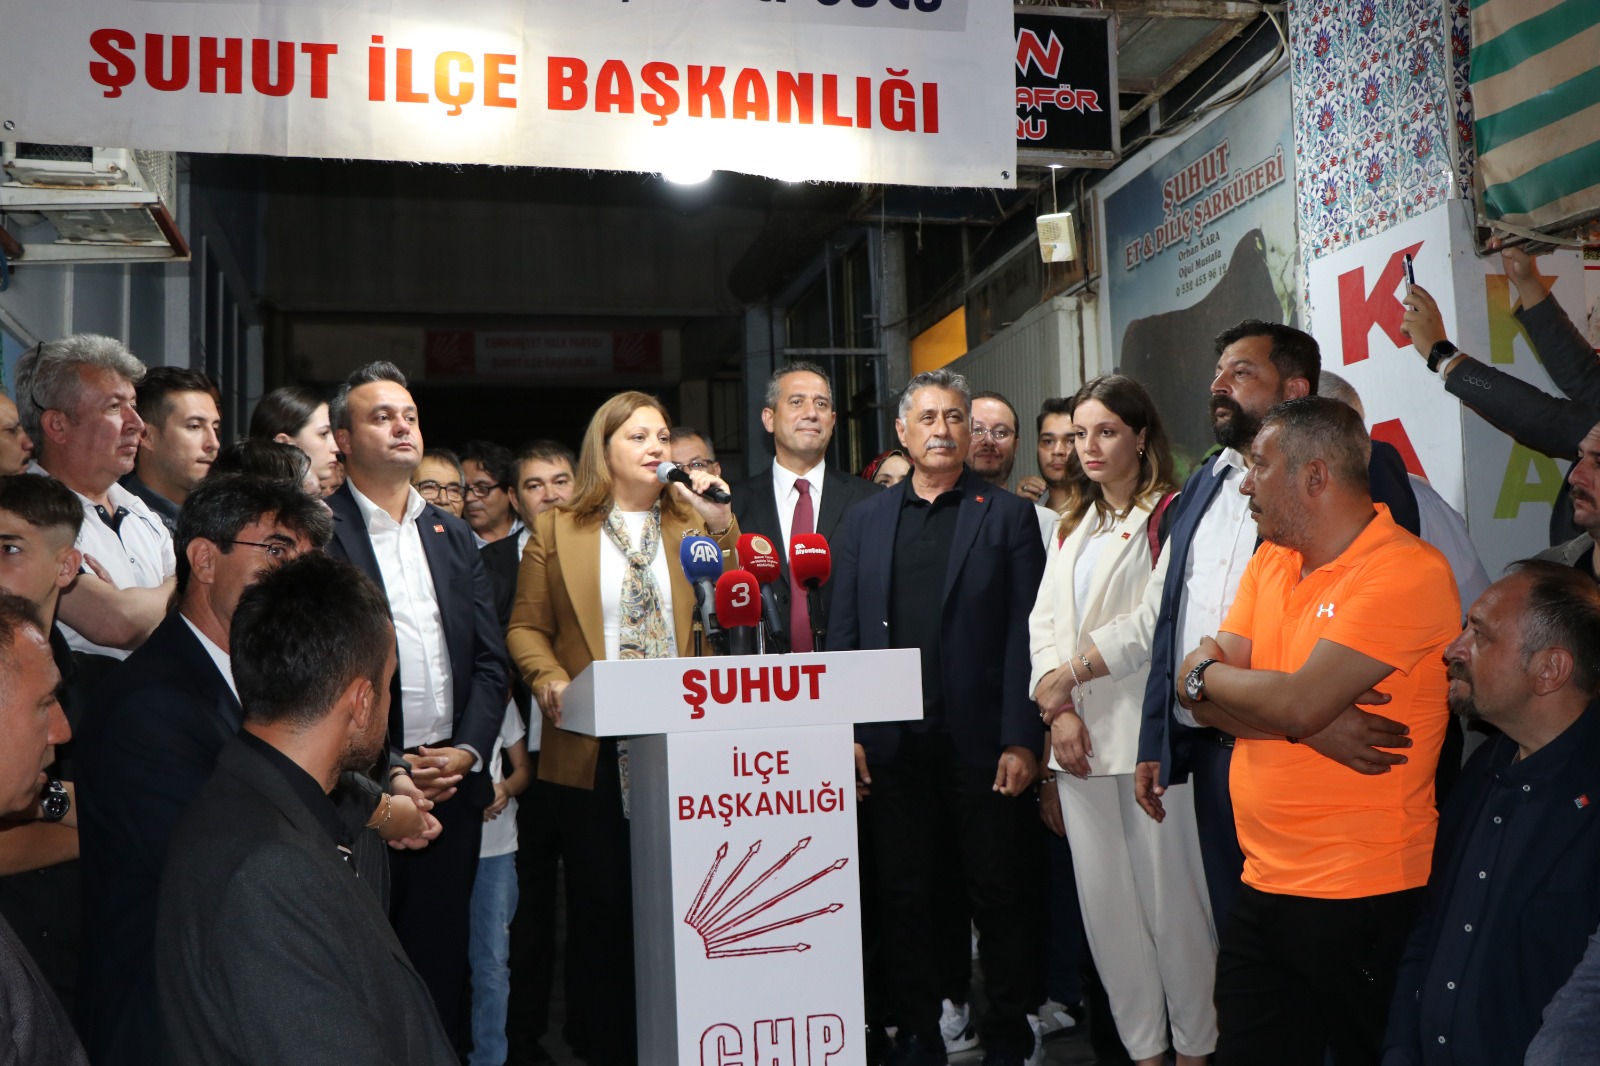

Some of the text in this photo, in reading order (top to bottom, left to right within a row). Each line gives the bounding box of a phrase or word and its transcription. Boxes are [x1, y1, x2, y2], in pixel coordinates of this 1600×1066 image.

[89, 28, 939, 134] ŞUHUT İLÇE BAŞKANLIĞI
[1163, 141, 1229, 217] ŞUHUT
[1125, 240, 1142, 269] ET
[1155, 211, 1192, 249] PİLİÇ
[1194, 147, 1285, 235] ŞARKÜTERİ
[1178, 231, 1221, 262] Orhan KARA
[1195, 249, 1222, 270] Mustafa
[692, 545, 719, 563] AA
[731, 582, 751, 608] 3
[682, 664, 827, 720] ŞUHUT
[733, 746, 790, 785] İLÇE
[678, 780, 845, 827] BAŞKANLIĞI
[700, 1013, 845, 1066] CHP
